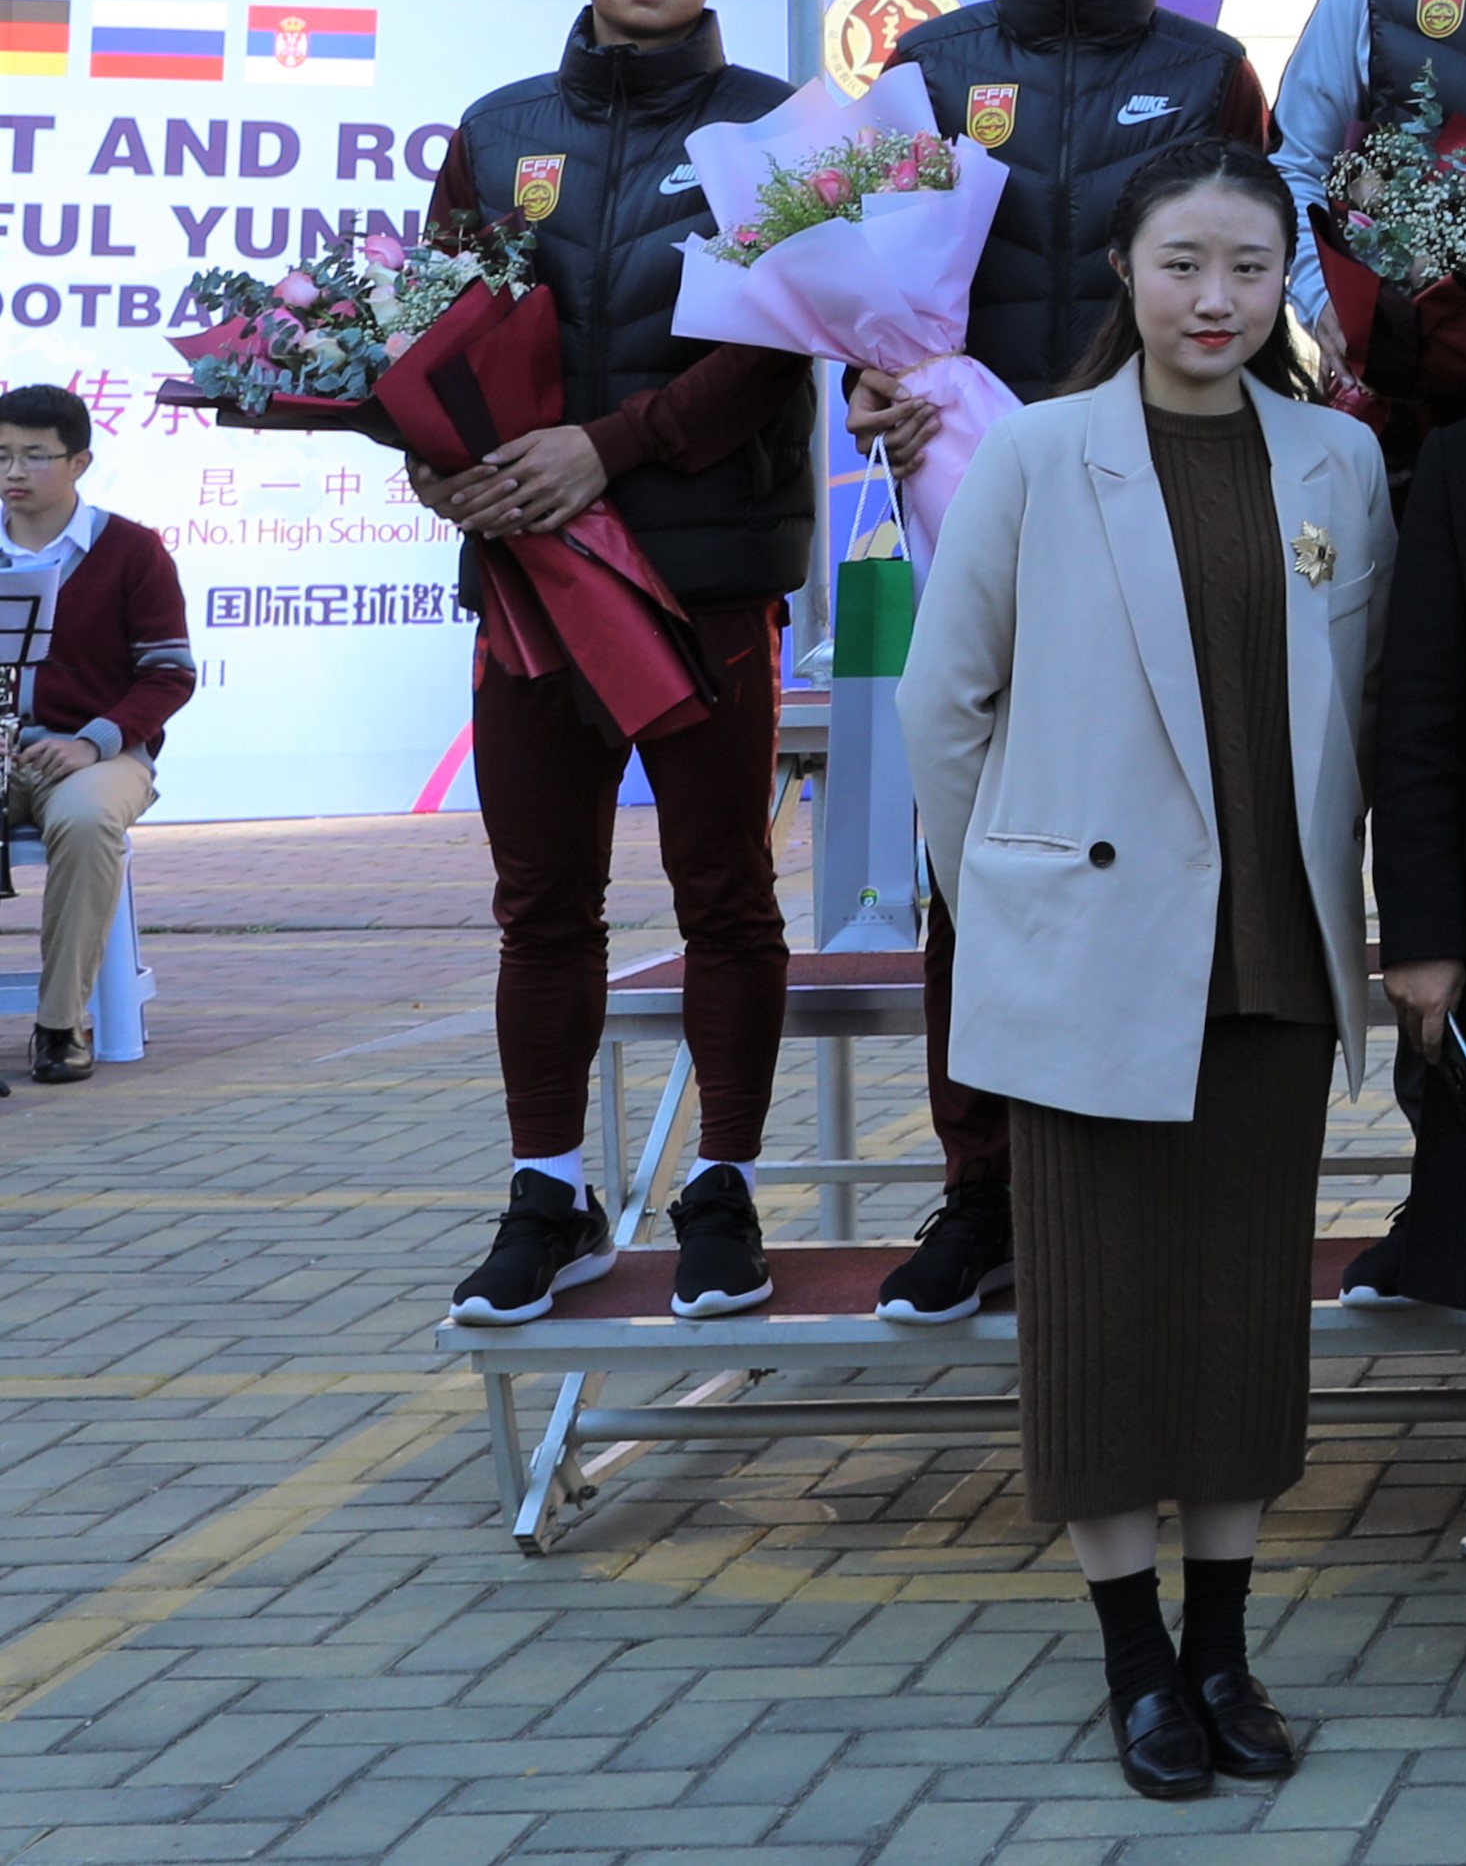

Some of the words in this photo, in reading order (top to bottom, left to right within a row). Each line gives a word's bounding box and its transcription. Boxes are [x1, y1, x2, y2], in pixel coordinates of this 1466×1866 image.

[973, 87, 1014, 101] CFA
[1127, 94, 1170, 113] NIKE
[89, 116, 301, 179] AND
[520, 158, 561, 174] CFA
[0, 202, 136, 257] UL
[0, 283, 218, 329] OTBA
[187, 518, 247, 545] No.1
[258, 518, 322, 551] High
[329, 515, 420, 544] School
